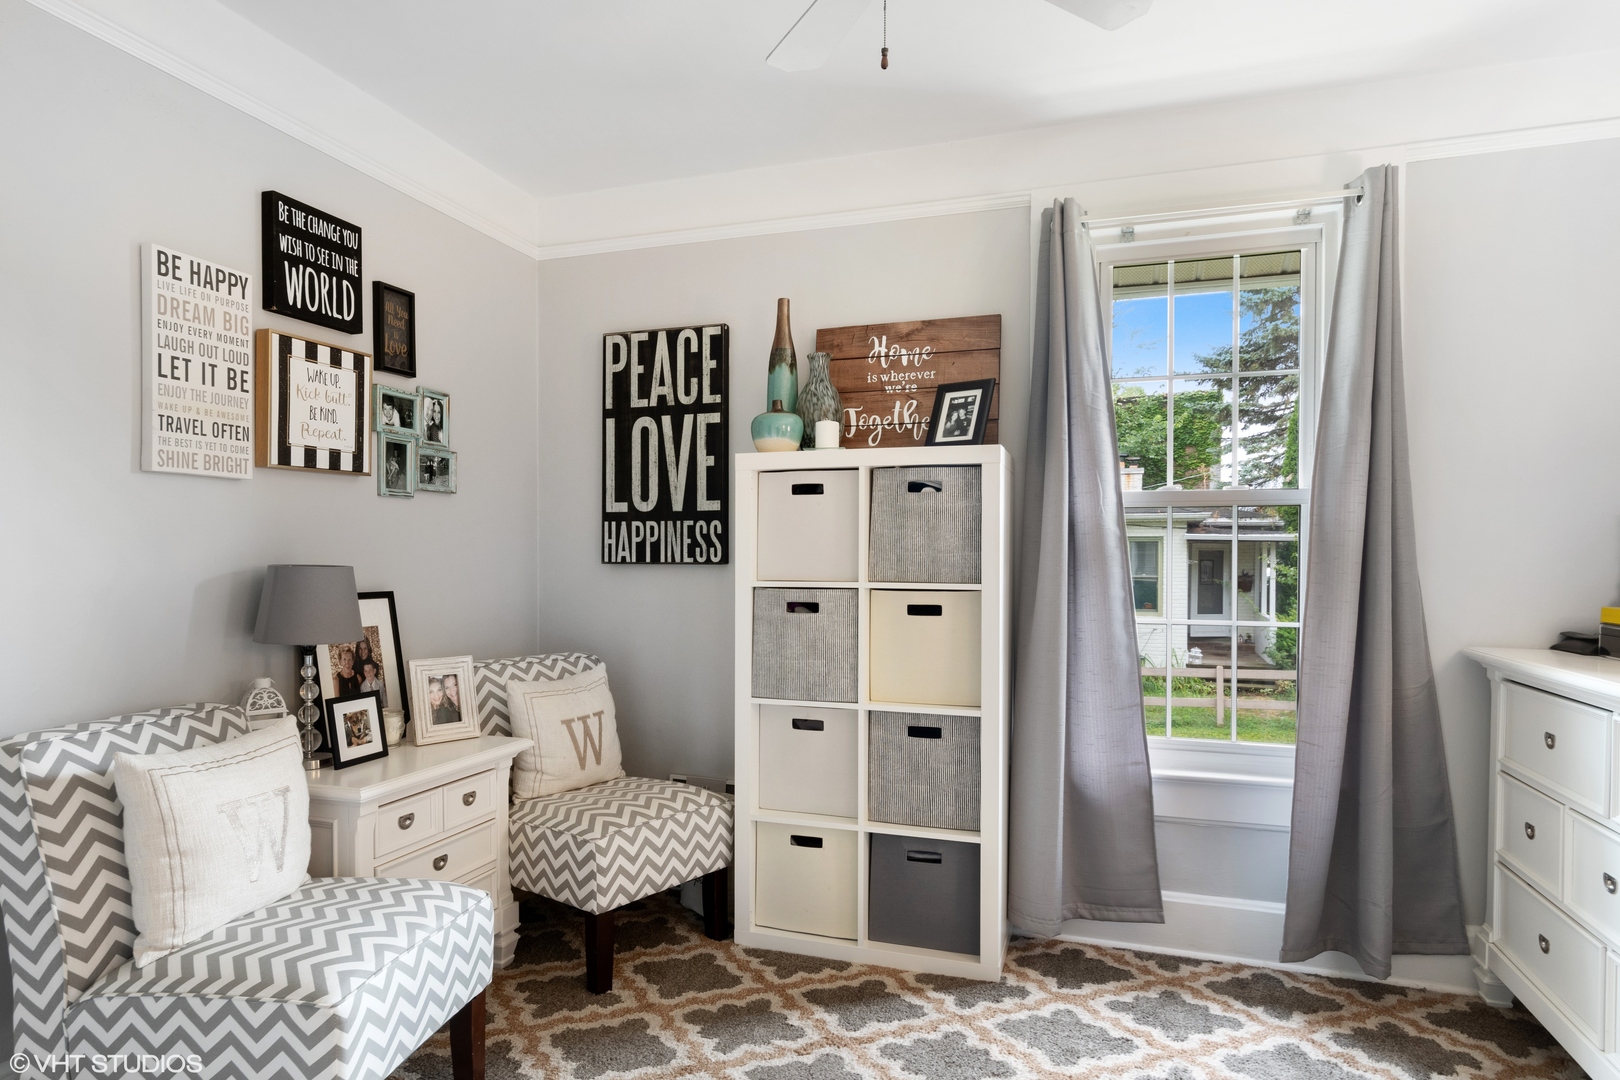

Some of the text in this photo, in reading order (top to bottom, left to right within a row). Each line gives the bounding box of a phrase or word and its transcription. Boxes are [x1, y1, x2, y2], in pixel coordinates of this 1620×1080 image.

[278, 201, 359, 250] BE THE CHANGE YOU
[279, 233, 359, 277] WISH TO SEE IN THE
[157, 249, 249, 300] BE HAPPY
[284, 260, 355, 321] WORLD
[157, 279, 249, 313] LIVE LIFE ON PURPOSE
[384, 301, 409, 320] All You
[157, 293, 249, 337] DREAM BIG
[157, 318, 249, 349] ENJOY EVERY MOMENT
[157, 333, 249, 367] LAUGH OUT LOUD
[385, 332, 408, 357] Love
[605, 326, 722, 410] PEACE
[868, 335, 936, 368] Home
[158, 353, 250, 393] LET IT BE
[307, 367, 341, 389] WAKE UP.
[867, 370, 936, 383] is wherever
[884, 381, 918, 394] we're
[158, 383, 249, 410] ENJOY THE JOURNEY
[296, 383, 352, 407] Kick butt.
[157, 401, 249, 423] WAKE UP & BE AWESOME
[158, 414, 250, 442] TRAVEL OFTEN
[309, 405, 338, 424] BE KIND.
[843, 400, 930, 447] Togethe
[158, 436, 250, 455] THE BEST IS YET TO COME
[300, 421, 346, 442] Repeat.
[157, 449, 250, 475] SHINE BRIGHT
[605, 412, 721, 513] LOVE
[604, 520, 722, 563] HAPPINESS
[561, 710, 605, 771] W
[217, 785, 291, 883] W
